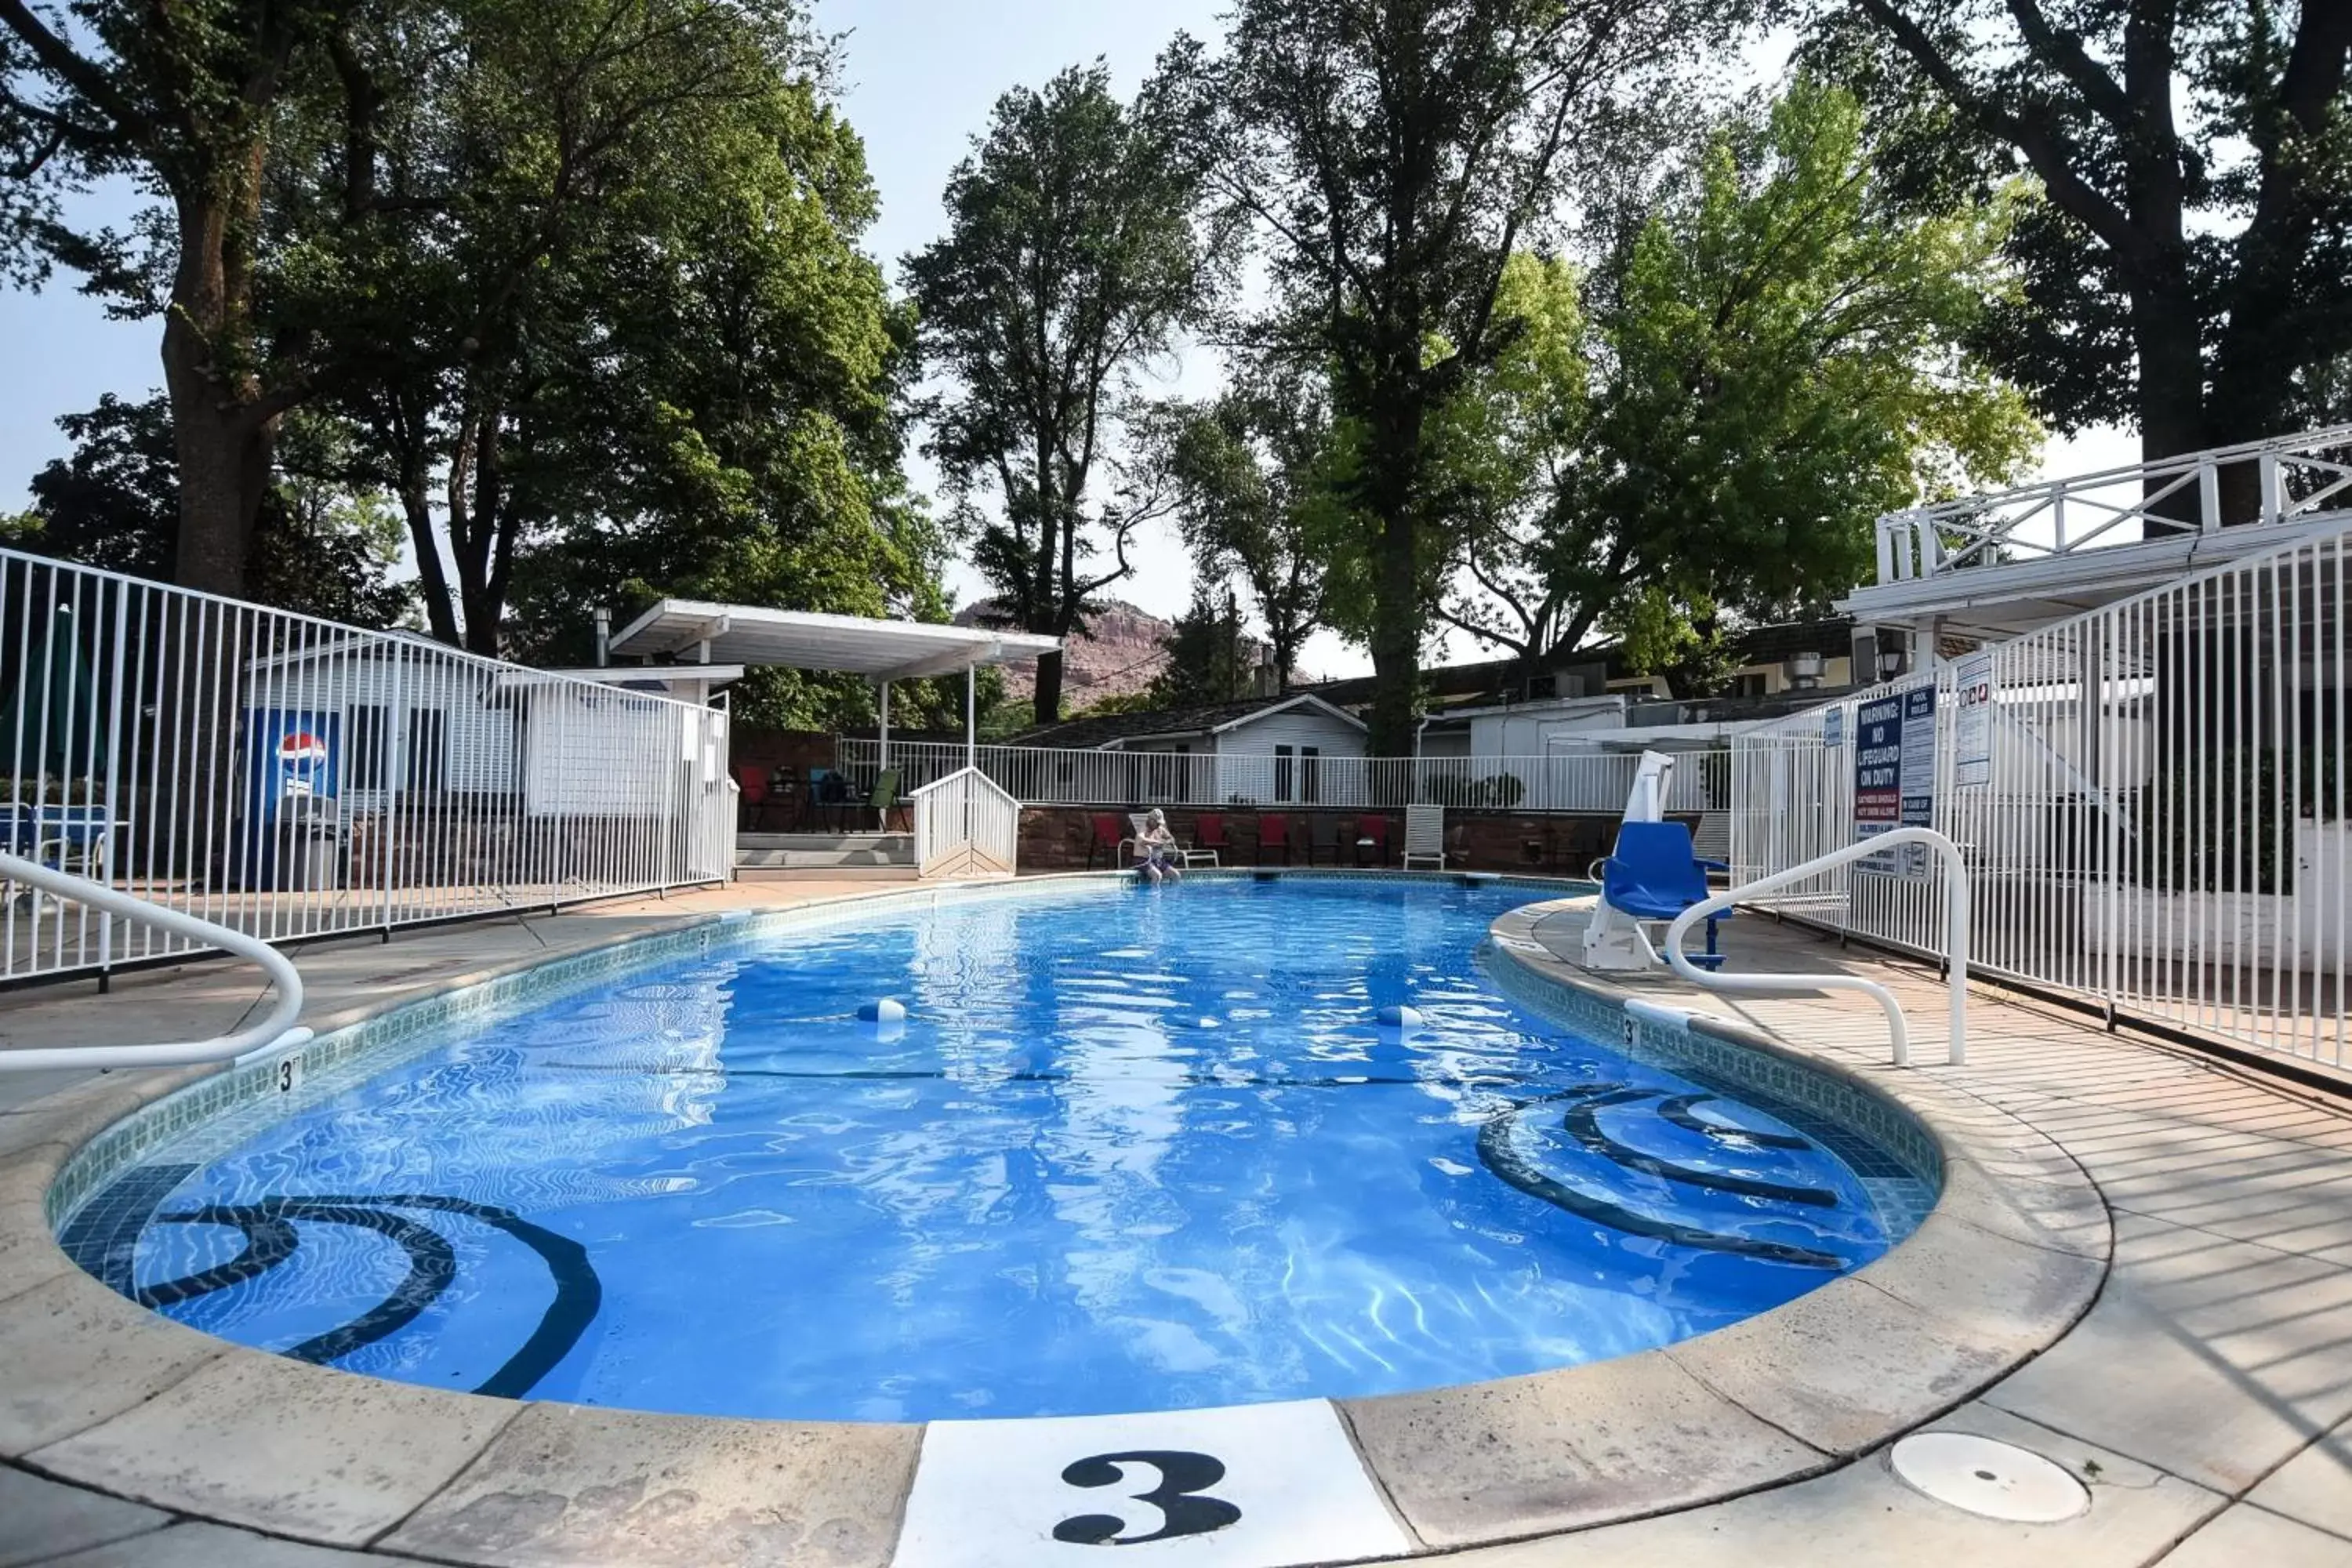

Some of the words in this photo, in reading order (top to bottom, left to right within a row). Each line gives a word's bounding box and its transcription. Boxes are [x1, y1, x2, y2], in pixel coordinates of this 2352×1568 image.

[1860, 702, 1899, 724] WARNING:
[1871, 726, 1884, 743] NO
[1857, 745, 1900, 766] LIFEGUARD
[1860, 770, 1871, 786] ON
[1873, 768, 1894, 786] DUTY
[1625, 1018, 1633, 1044] 3
[281, 1061, 291, 1091] 3
[1052, 1450, 1243, 1545] 3
